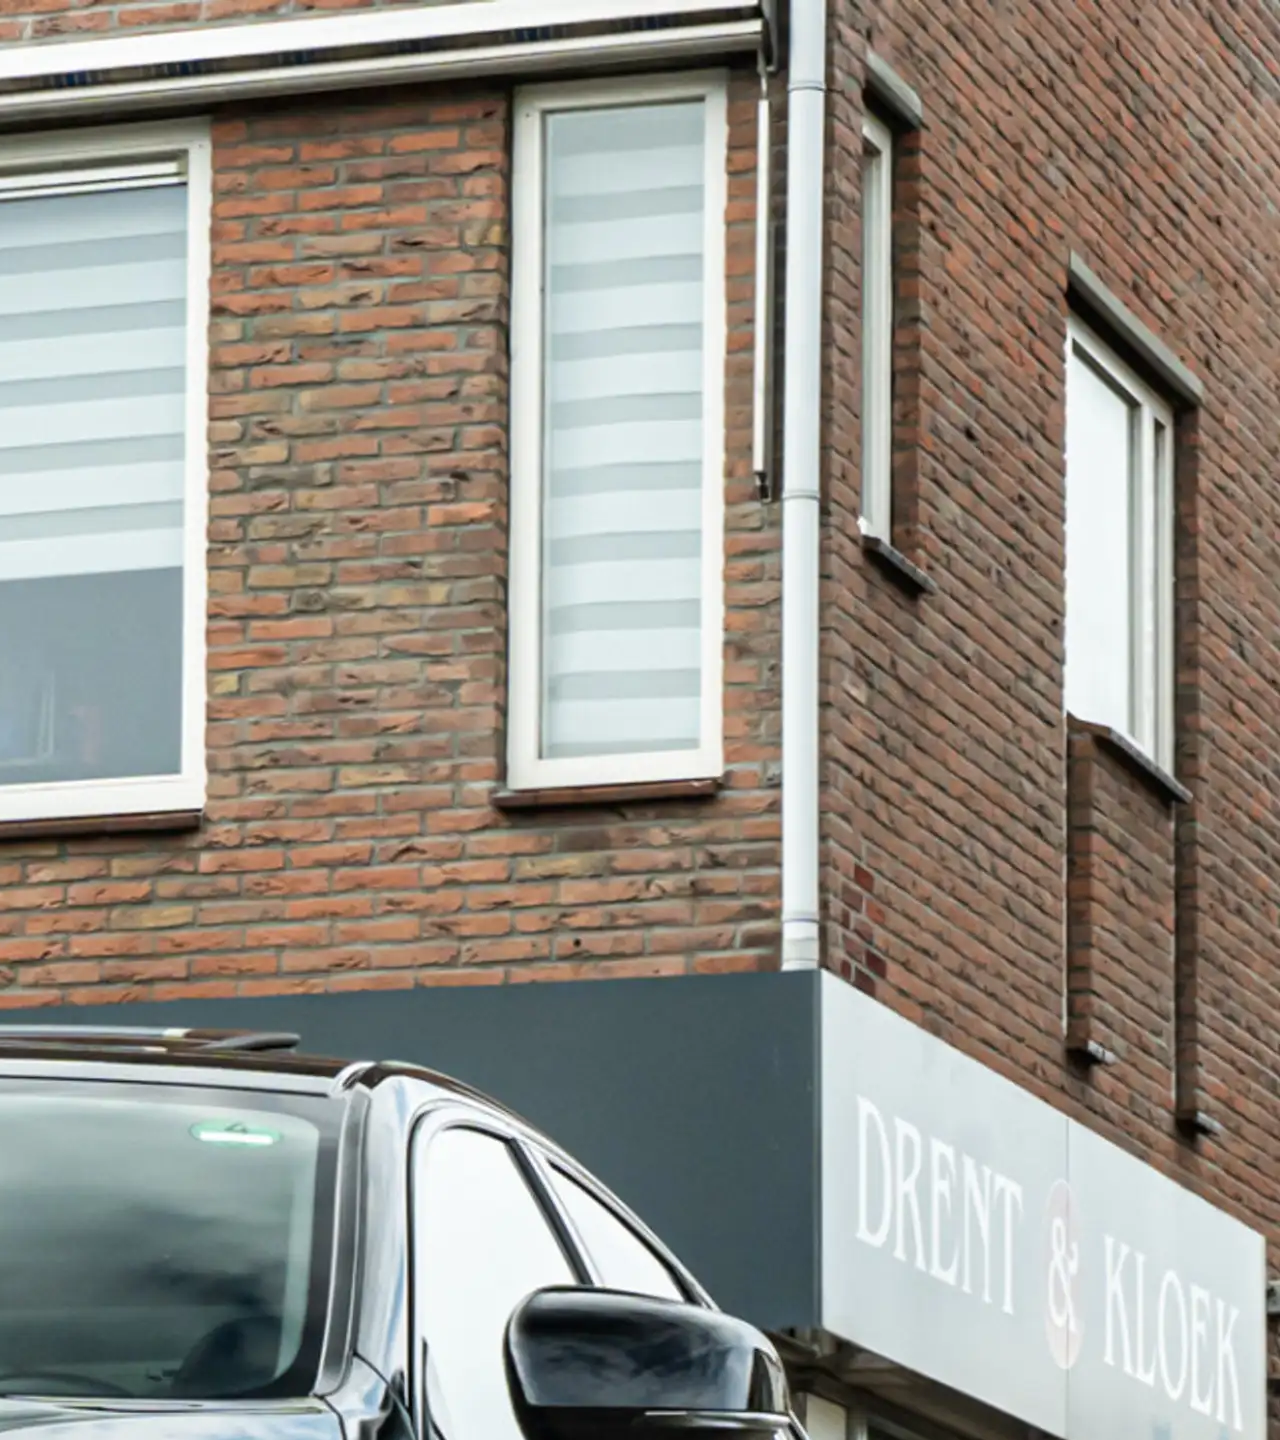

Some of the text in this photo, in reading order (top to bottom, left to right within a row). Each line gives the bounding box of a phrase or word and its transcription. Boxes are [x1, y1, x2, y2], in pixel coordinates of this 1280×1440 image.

[856, 1094, 1243, 1433] DRENT & KLOEK
